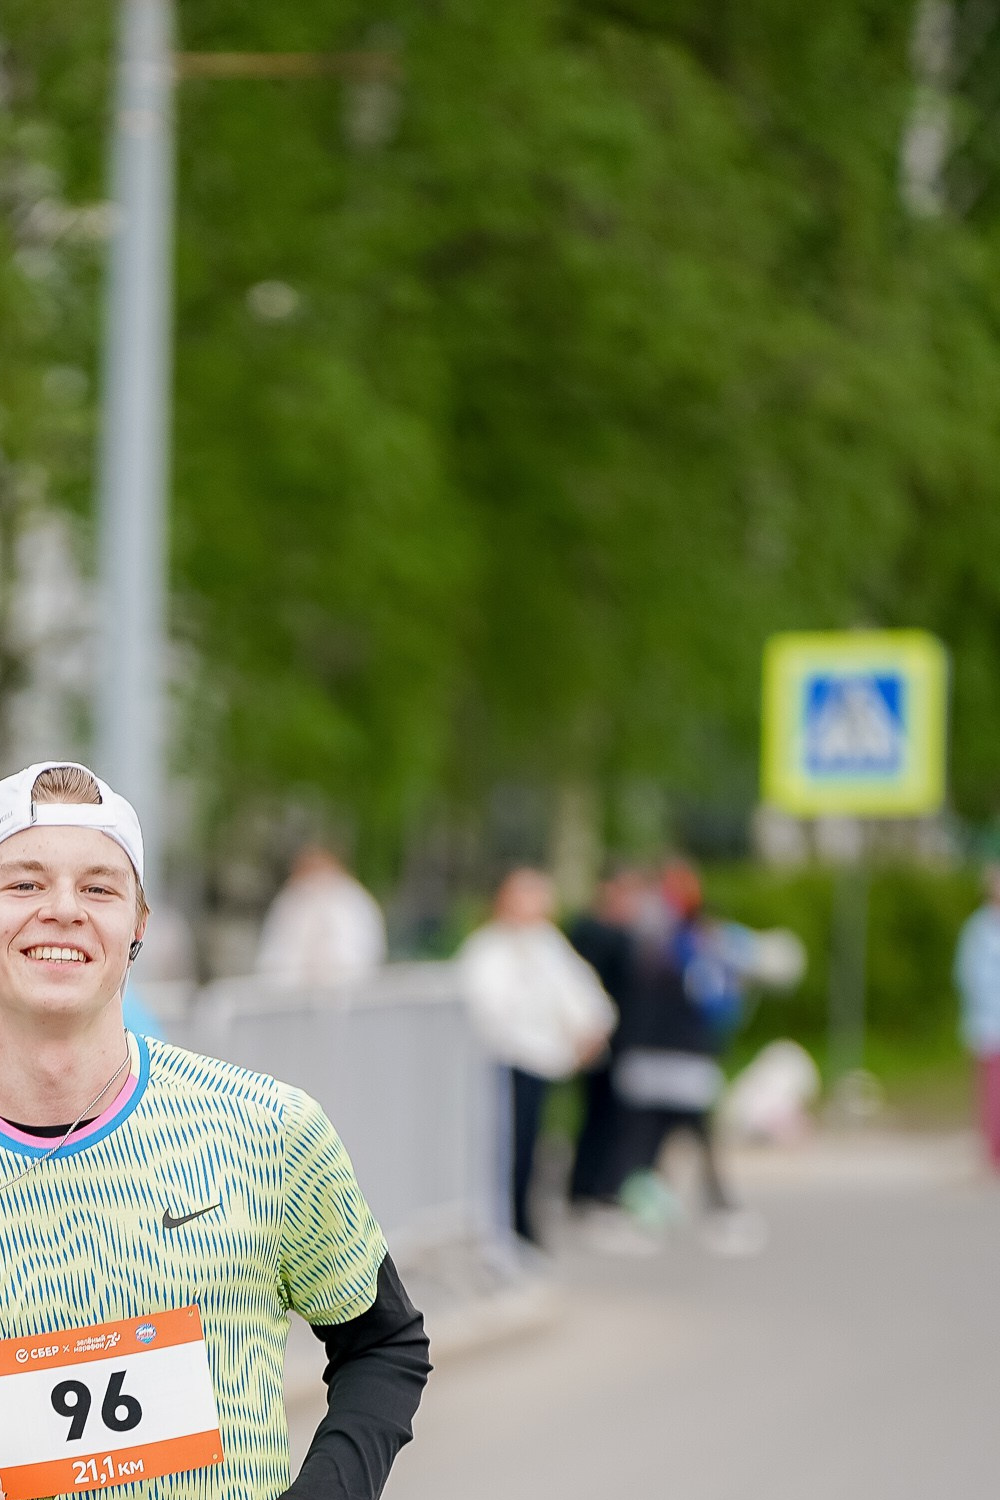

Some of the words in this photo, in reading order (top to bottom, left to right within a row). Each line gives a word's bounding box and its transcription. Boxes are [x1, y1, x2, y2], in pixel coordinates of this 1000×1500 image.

[30, 1345, 59, 1359] СБЕР
[50, 1369, 143, 1442] 96
[72, 1455, 115, 1485] 21,1
